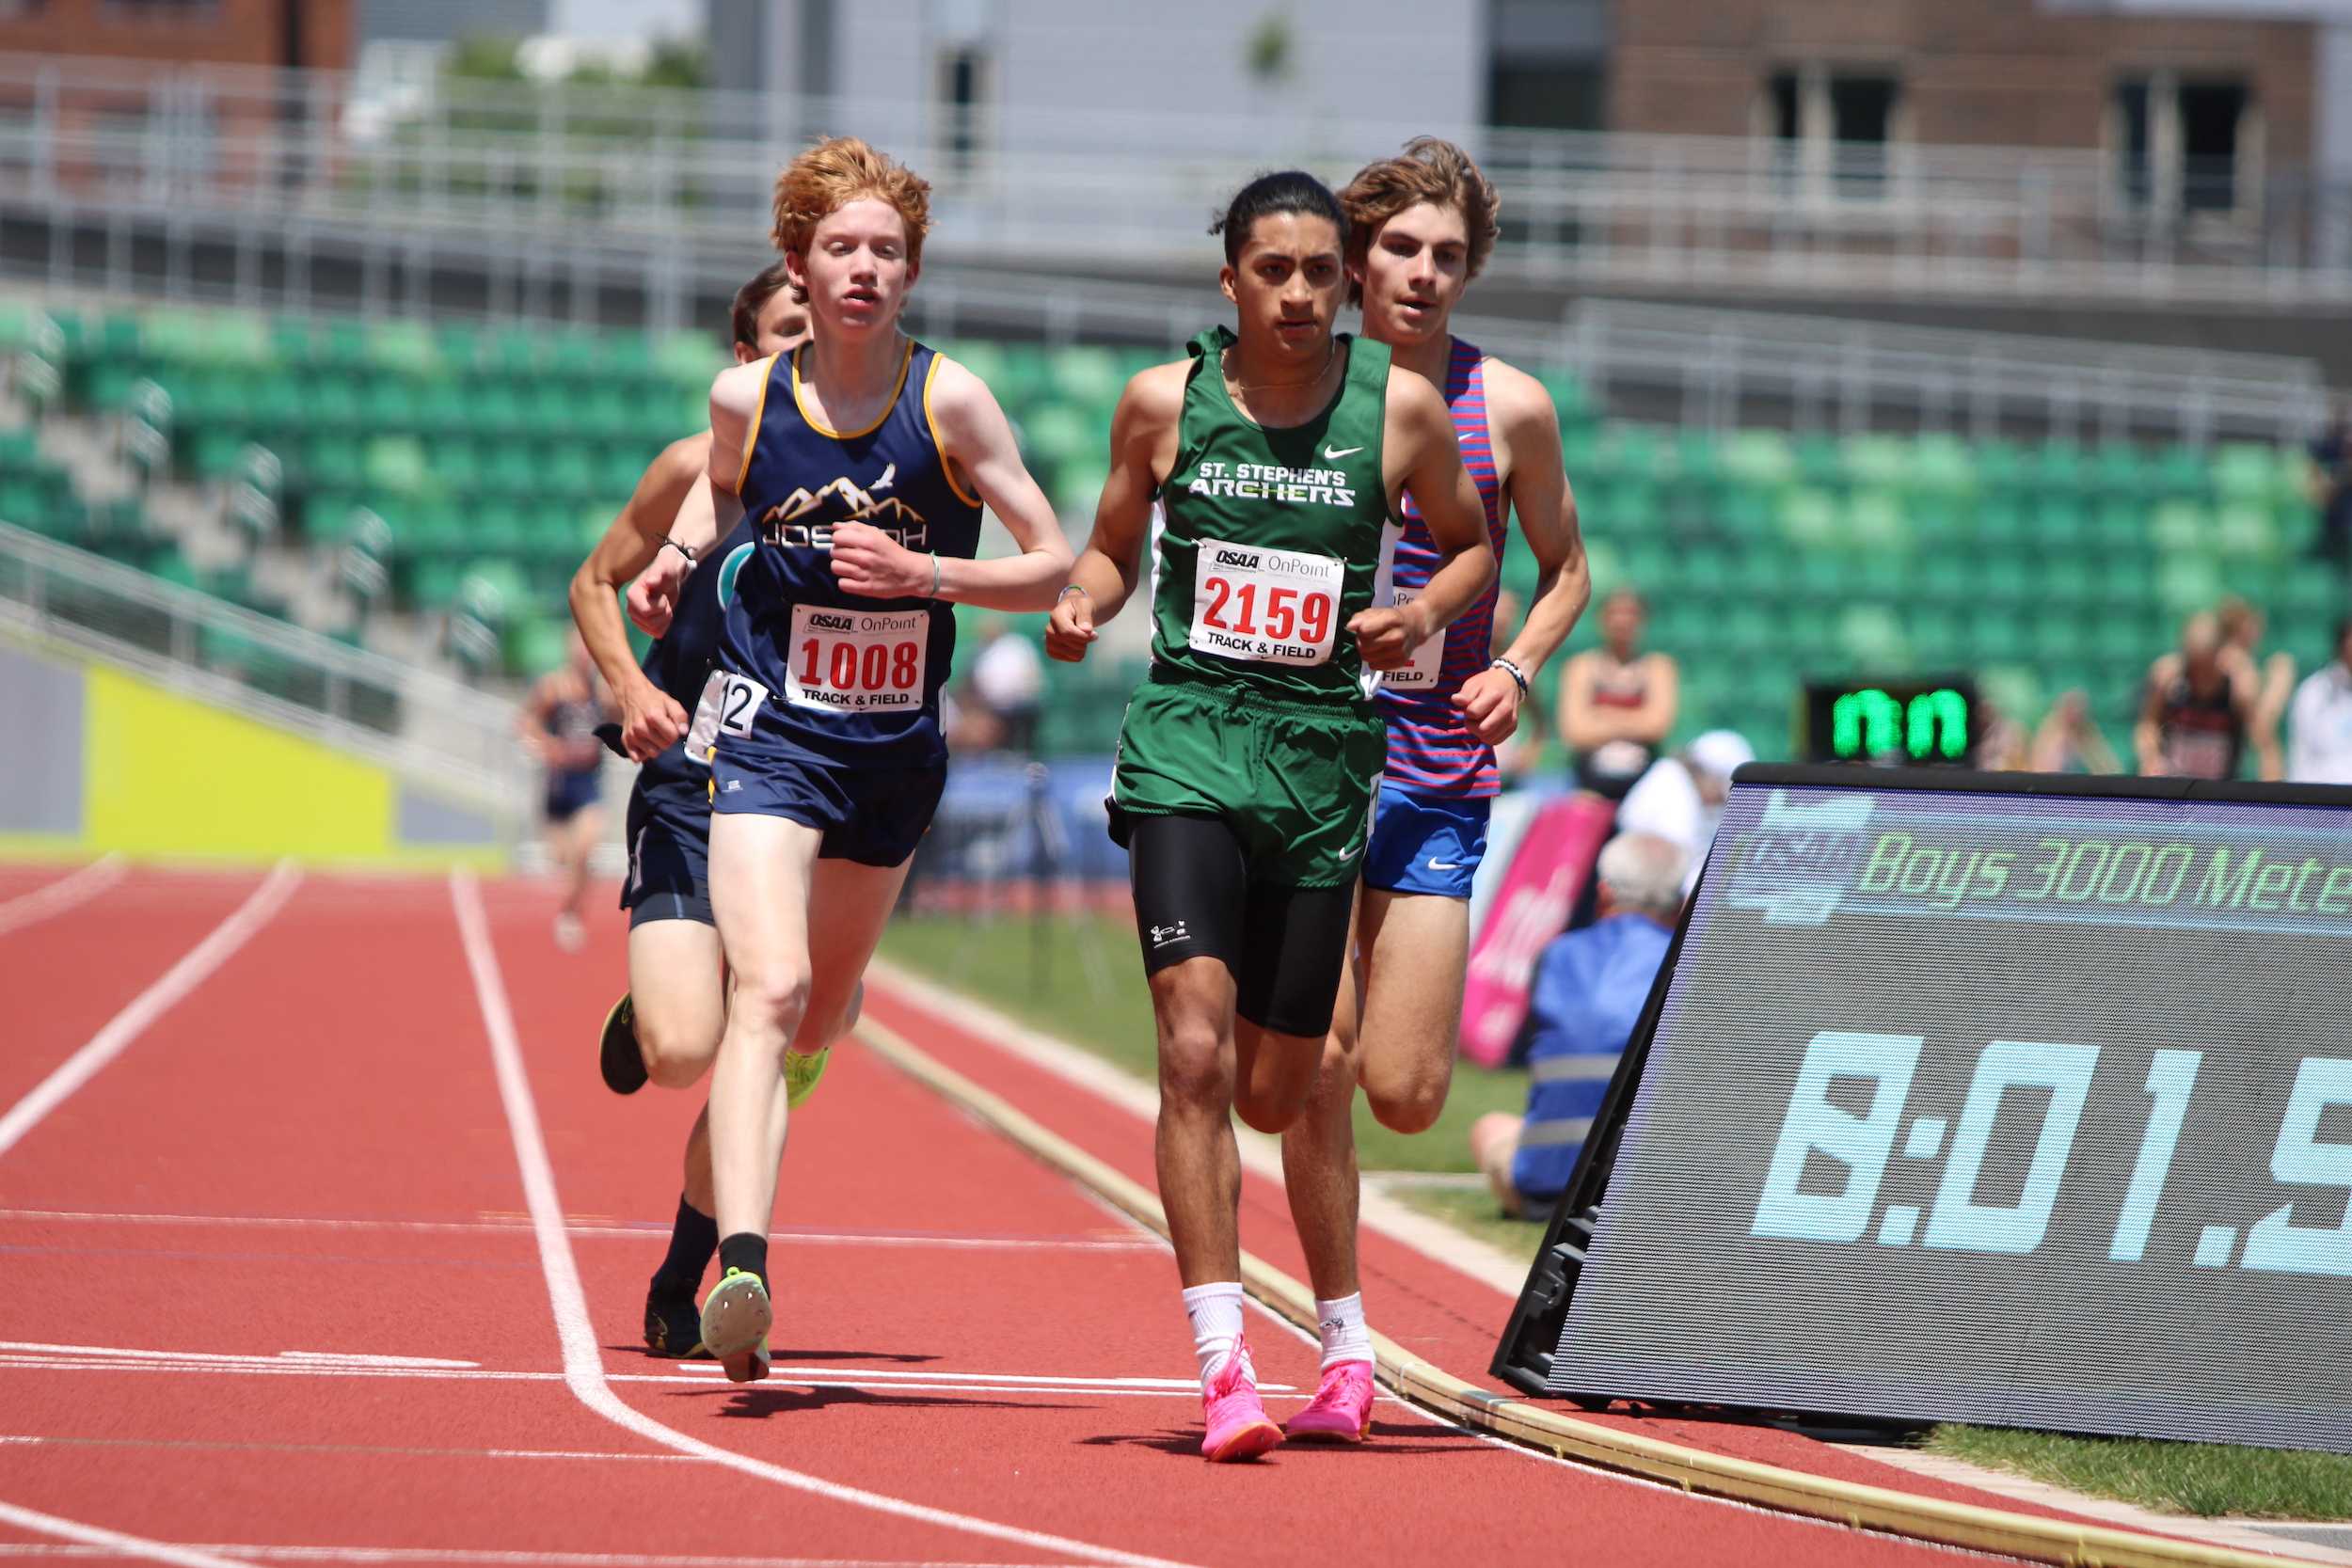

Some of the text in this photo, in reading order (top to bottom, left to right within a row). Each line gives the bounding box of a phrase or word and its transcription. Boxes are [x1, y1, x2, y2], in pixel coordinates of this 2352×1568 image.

[1200, 462, 1346, 487] ST. STEPHEN'S
[1188, 478, 1356, 507] ARCHERS
[762, 523, 927, 549] JOSH
[1216, 549, 1260, 569] OSAA
[1268, 555, 1330, 578] OnPoint
[810, 613, 853, 630] OSAA
[861, 617, 916, 631] OnPoint
[1203, 576, 1331, 643] 2159
[1207, 632, 1317, 658] TRACK & FIELD
[799, 638, 918, 690] 1008
[1383, 671, 1423, 682] FIELD
[803, 689, 909, 705] TRACK & FIELD
[1858, 832, 2019, 911] Boys
[2016, 836, 2196, 905] 3000
